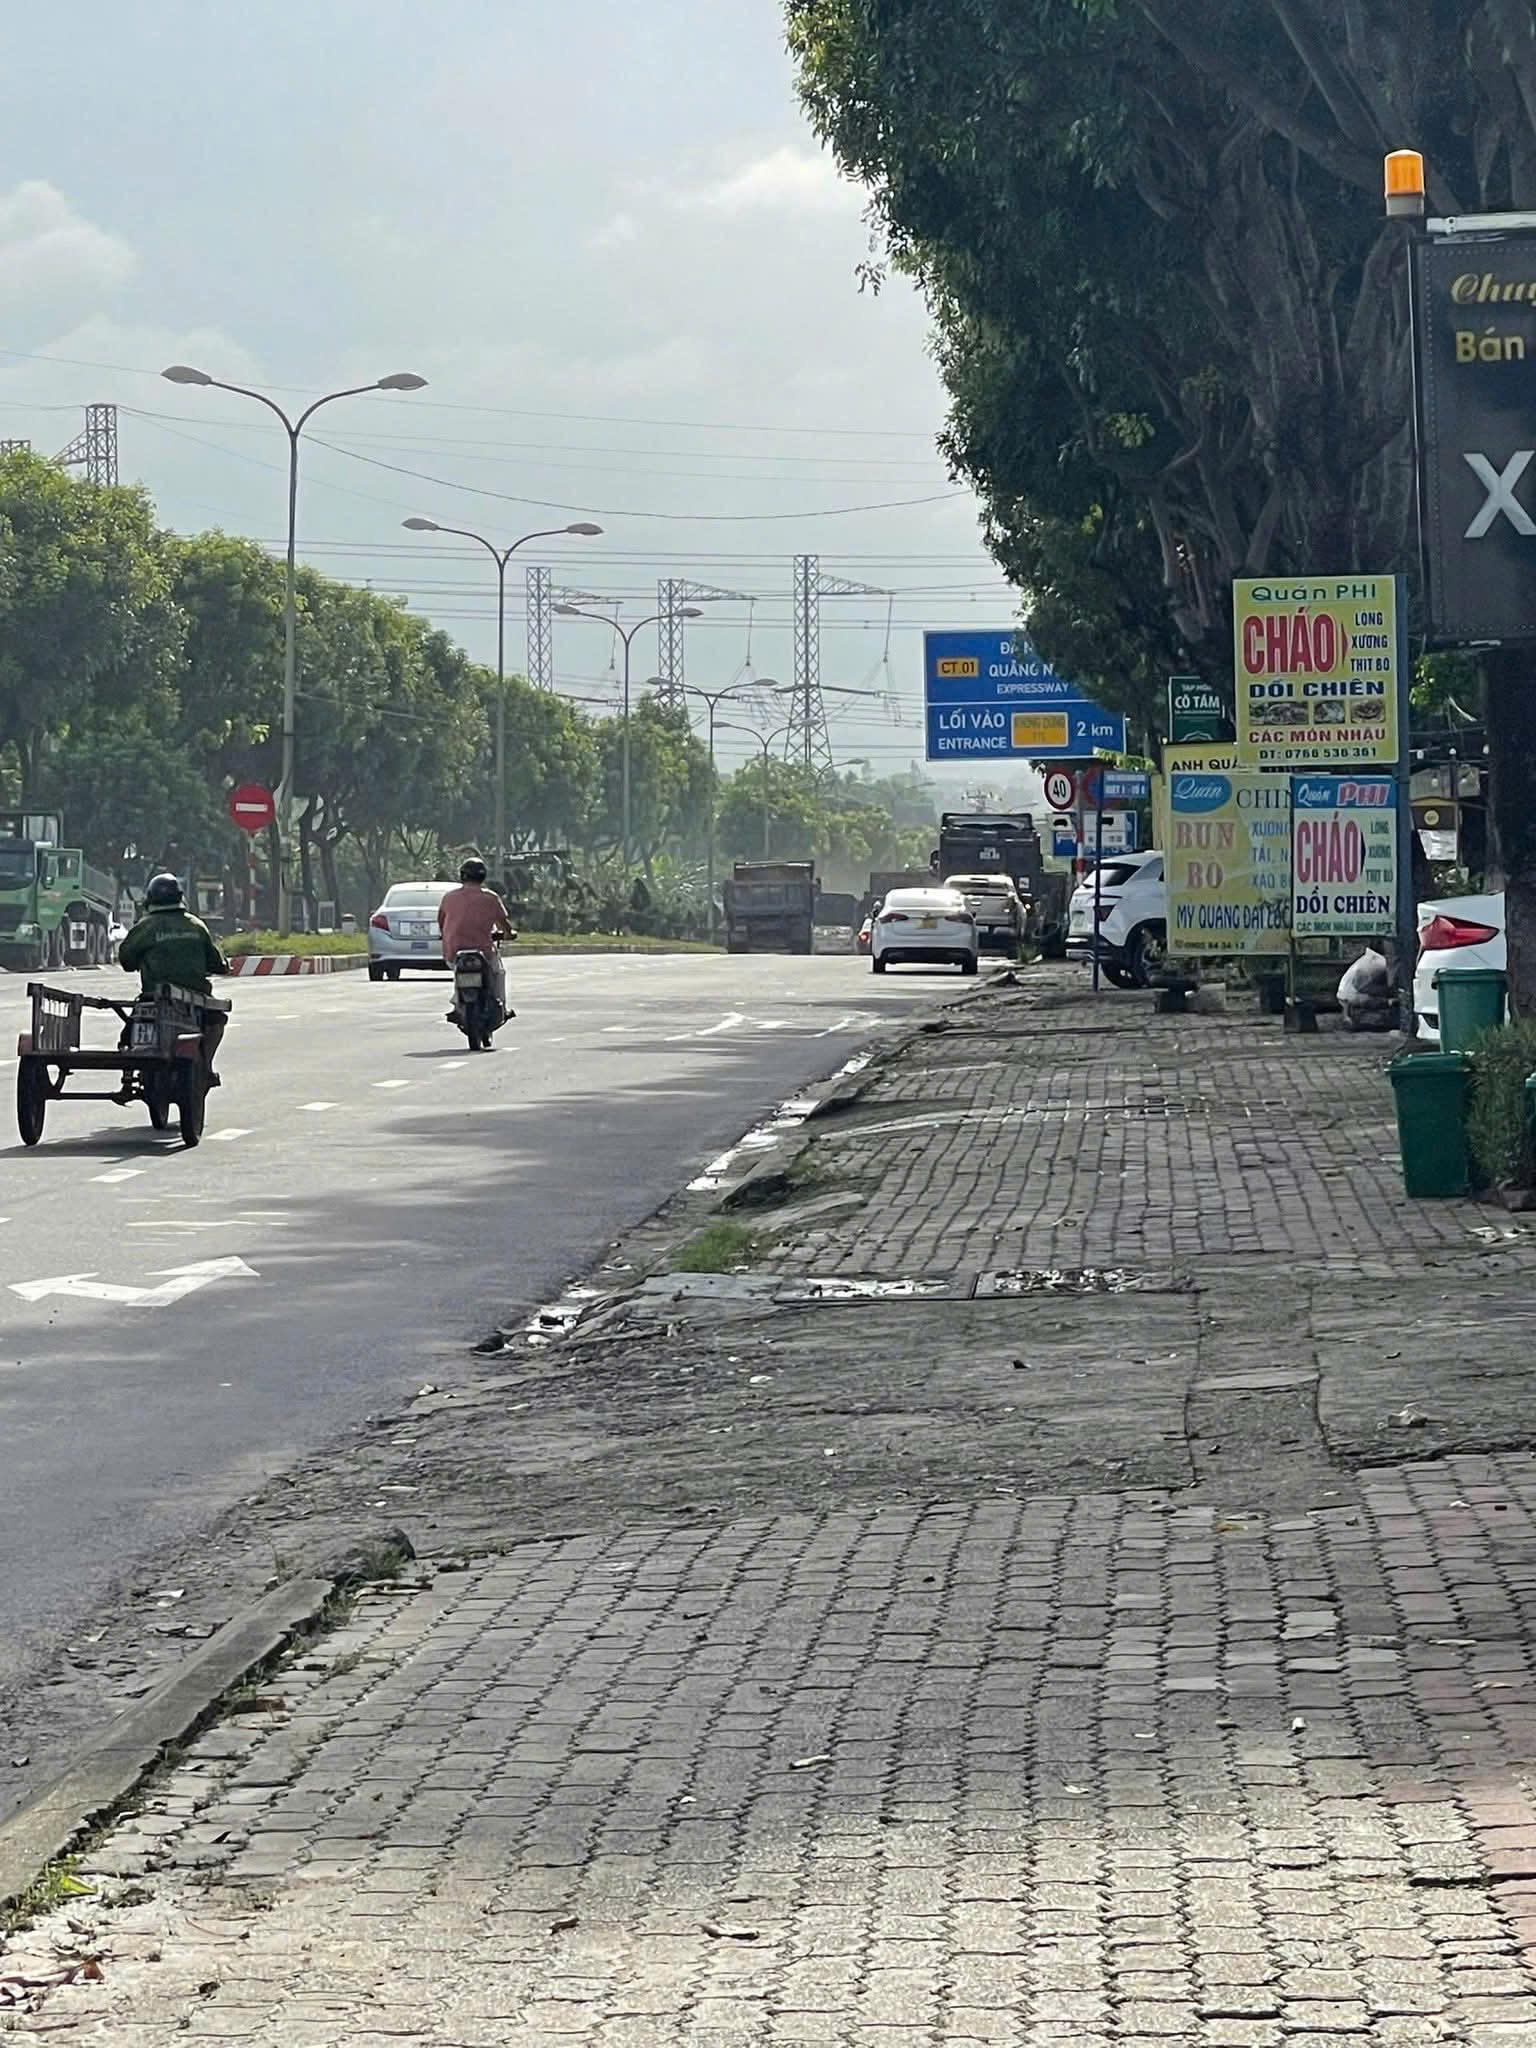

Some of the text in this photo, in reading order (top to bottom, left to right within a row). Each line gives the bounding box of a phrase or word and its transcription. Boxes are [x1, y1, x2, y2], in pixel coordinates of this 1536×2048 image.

[1456, 326, 1525, 363] Bán
[1463, 450, 1536, 538] X
[1252, 584, 1376, 601] Quán PHI
[1243, 605, 1337, 675] CHÁO
[997, 683, 1069, 695] EXPRESSWAY
[1303, 678, 1385, 697] CHIÊN
[1175, 694, 1190, 709] CÔ
[939, 708, 966, 729] LỐI
[970, 709, 1005, 728] VÀO
[1076, 722, 1113, 737] 2 km
[1249, 728, 1284, 743] CÁC
[1337, 728, 1386, 743] NHẬU
[938, 737, 1008, 750] ENTRANCE
[1171, 760, 1203, 771] ANH
[1053, 780, 1066, 798] 40
[1336, 782, 1391, 807] PHI
[1297, 811, 1359, 884] CHÁO
[1334, 890, 1390, 914] CHIÊN
